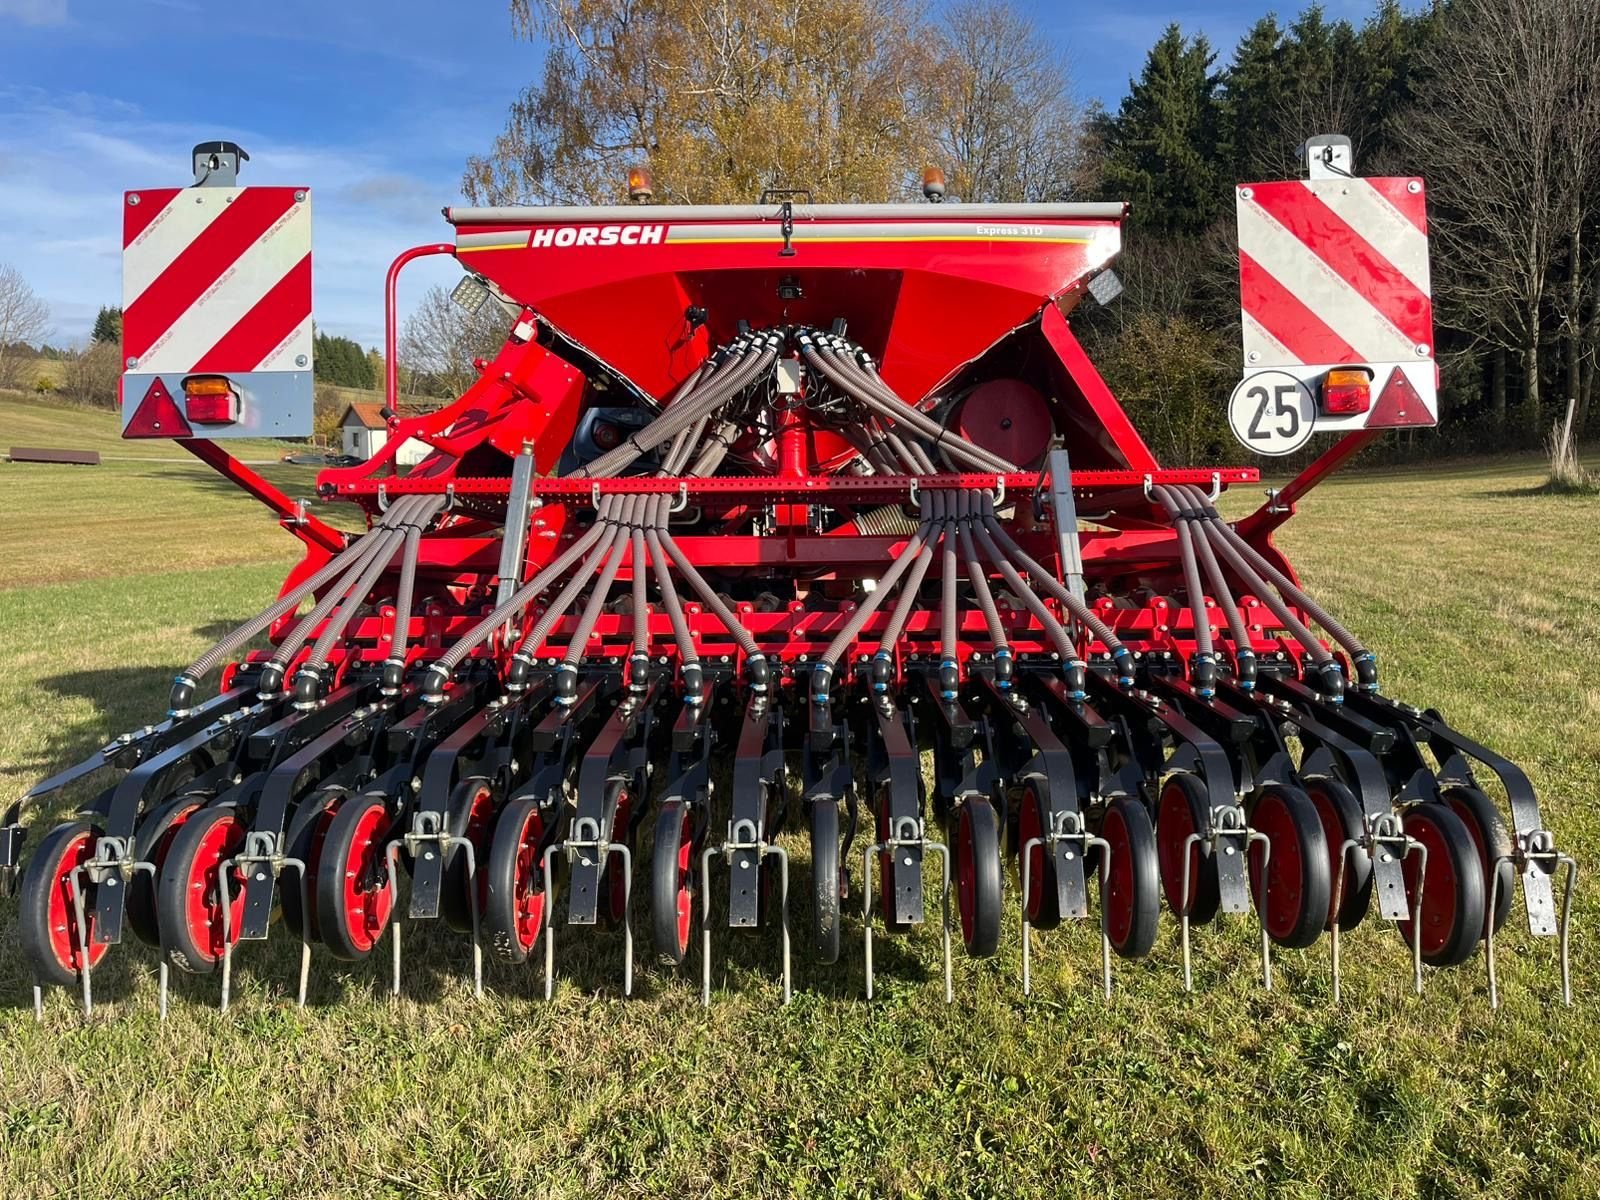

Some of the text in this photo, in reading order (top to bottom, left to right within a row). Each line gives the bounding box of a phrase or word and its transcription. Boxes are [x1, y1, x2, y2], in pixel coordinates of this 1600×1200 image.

[531, 225, 664, 248] HORSCH
[976, 225, 1019, 236] Express
[1246, 385, 1299, 439] 25
